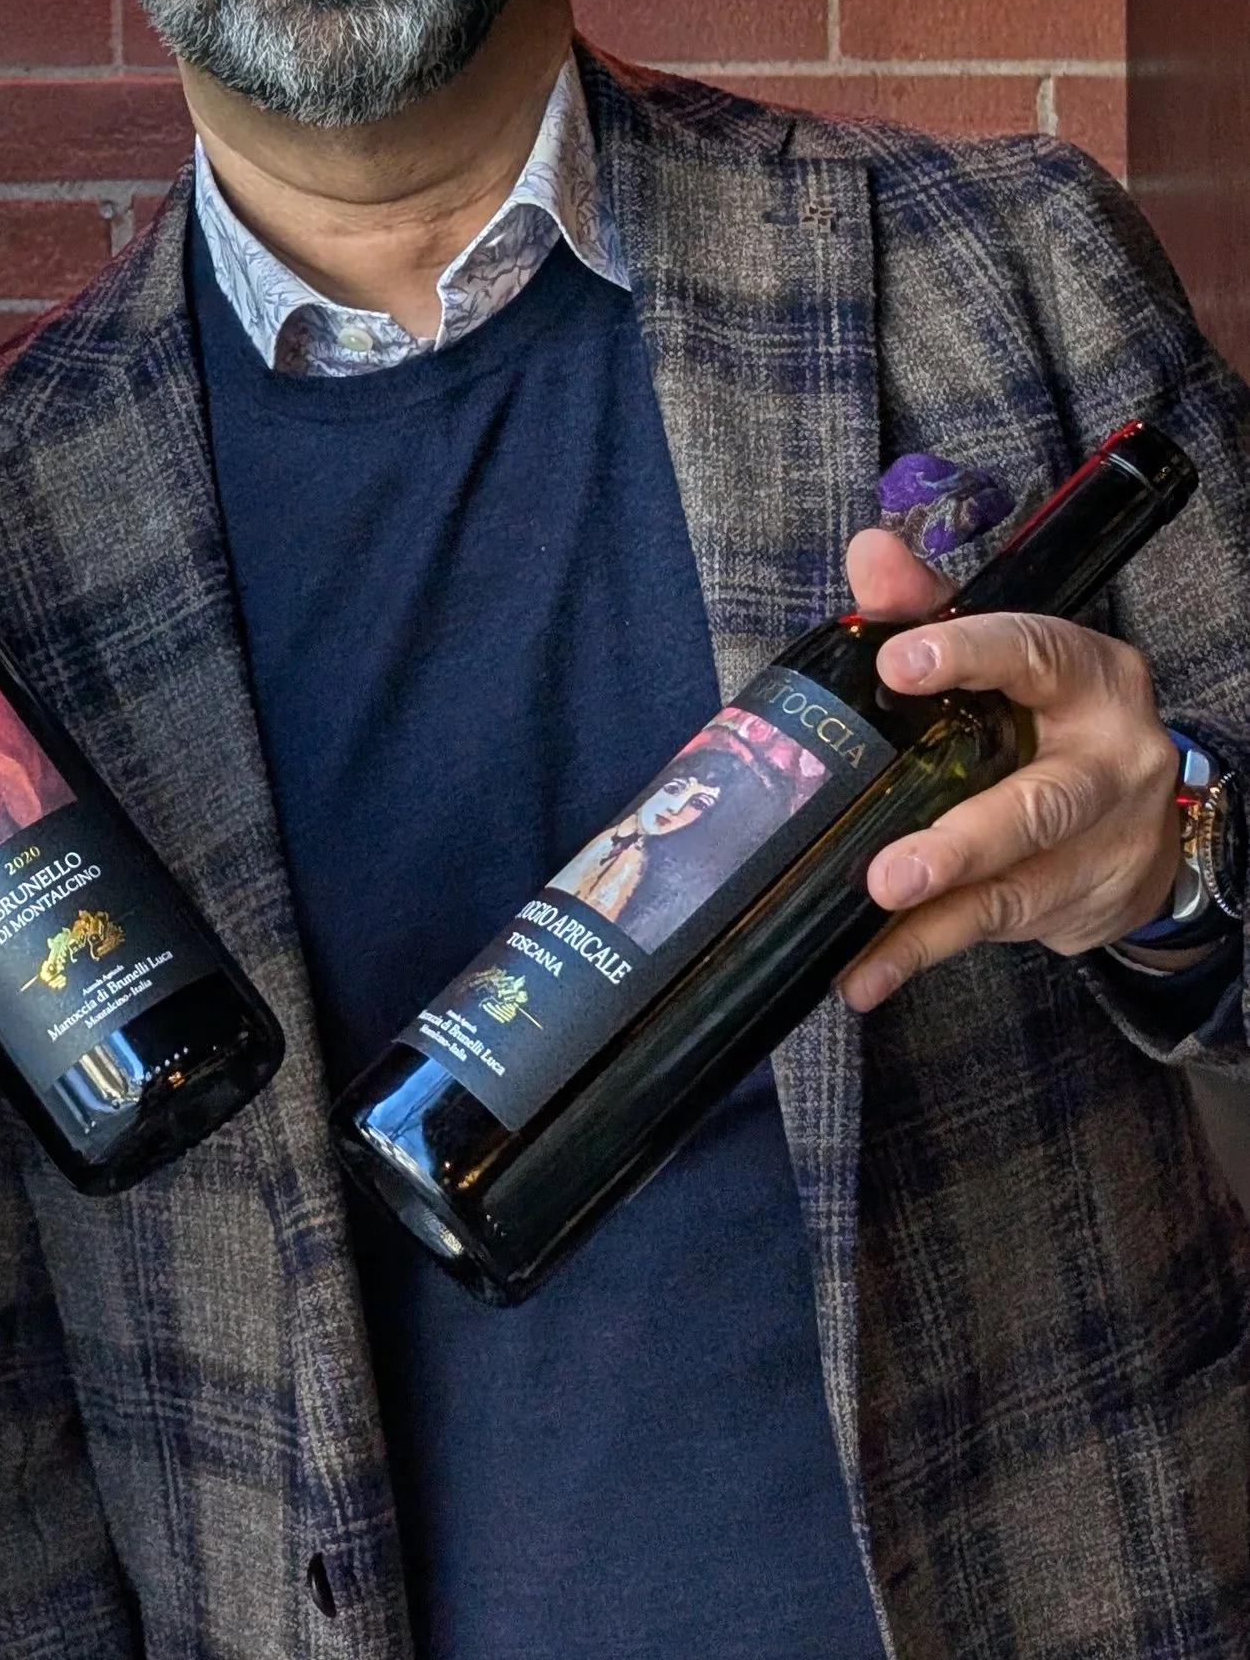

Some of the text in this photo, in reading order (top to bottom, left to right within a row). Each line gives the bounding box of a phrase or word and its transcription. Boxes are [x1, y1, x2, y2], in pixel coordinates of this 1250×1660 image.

[4, 845, 41, 876] 2020
[9, 864, 102, 933] MONTALCINO
[506, 931, 564, 978] TOSCANA
[546, 914, 633, 985] APRICALE
[47, 950, 174, 1042] Martoccia di Brunelli Luca
[447, 1023, 485, 1057] Brunelli
[480, 1048, 506, 1077] Luca
